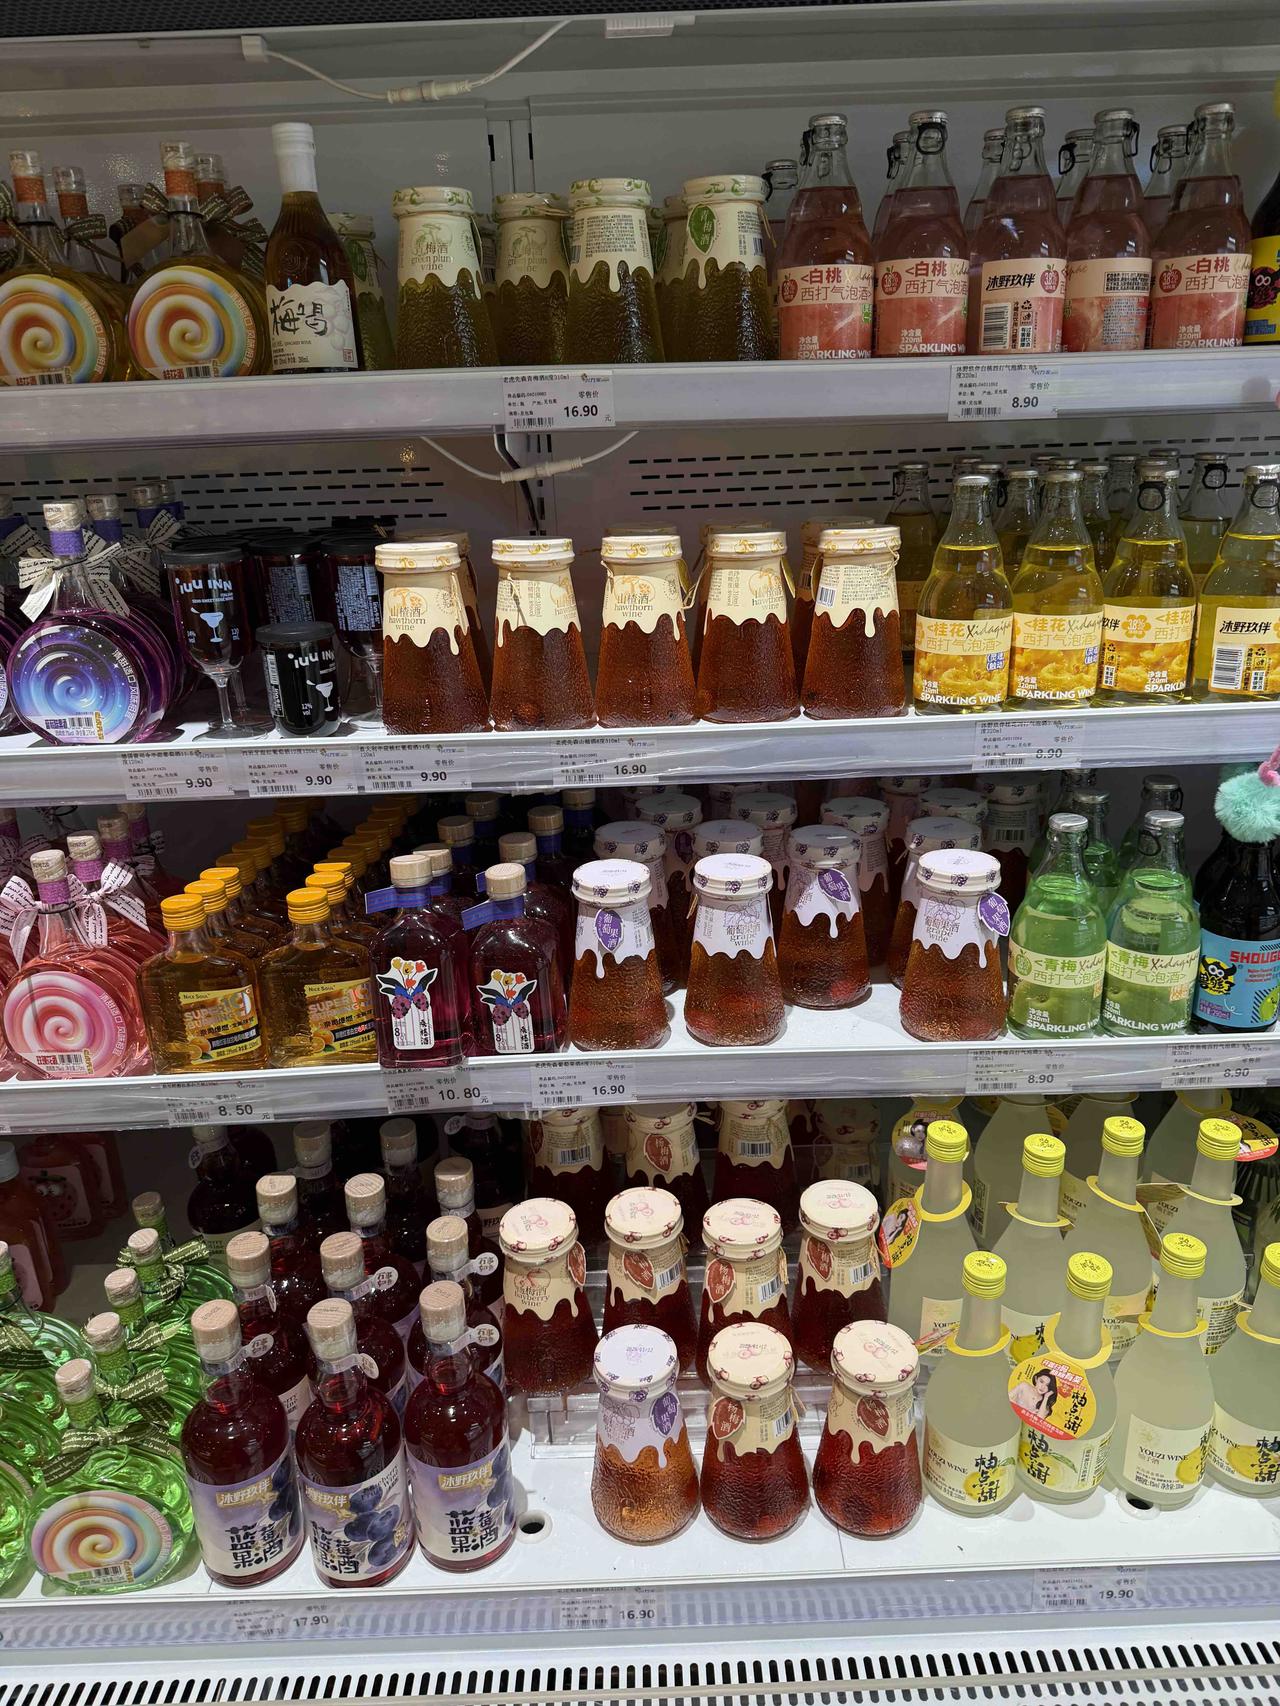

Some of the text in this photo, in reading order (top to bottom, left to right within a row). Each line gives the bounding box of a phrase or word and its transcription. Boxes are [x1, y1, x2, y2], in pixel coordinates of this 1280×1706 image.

[986, 273, 1036, 291] 沐野玖伴
[899, 343, 957, 353] SPARKLING
[1175, 337, 1235, 348] SPARKLING
[797, 349, 857, 360] SPARKLING
[1029, 382, 1050, 390] 零售价
[578, 390, 599, 399] 零售价
[1012, 396, 1039, 408] 8.90
[564, 404, 599, 418] 16.90
[207, 579, 233, 591] INN
[614, 604, 654, 612] hawthorn
[1219, 620, 1272, 634] 沐野玖伴
[920, 693, 1001, 705] SPARKLING WINE
[1015, 689, 1076, 700] SPARKLING
[1036, 748, 1063, 759] 8.90
[319, 763, 340, 771] 零售价
[614, 764, 647, 775] 16.90
[305, 775, 333, 786] 9.90
[420, 771, 447, 782] 9.90
[186, 777, 213, 788] 9.90
[602, 913, 619, 948] 葡萄果酒
[926, 927, 953, 937] grape
[929, 933, 949, 942] wine
[1026, 1021, 1087, 1033] SPARKLING
[1103, 1012, 1186, 1031] SPARKLING WINE
[1223, 1067, 1250, 1078] 8.90
[1027, 1074, 1055, 1084] 8.90
[438, 1087, 481, 1101] 10.80
[592, 1084, 625, 1096] 16.90
[218, 1104, 253, 1117] 8.50
[1139, 1446, 1189, 1462] YOUZI WINE
[947, 1464, 969, 1475] WINE
[442, 1464, 492, 1488] 沐野玖伴
[219, 1478, 270, 1505] 沐野玖伴
[450, 1529, 499, 1554] 果酒
[233, 1539, 284, 1570] 果酒
[1099, 1589, 1134, 1600] 19.90
[620, 1609, 655, 1620] 16.90
[293, 1615, 329, 1627] 17.90
